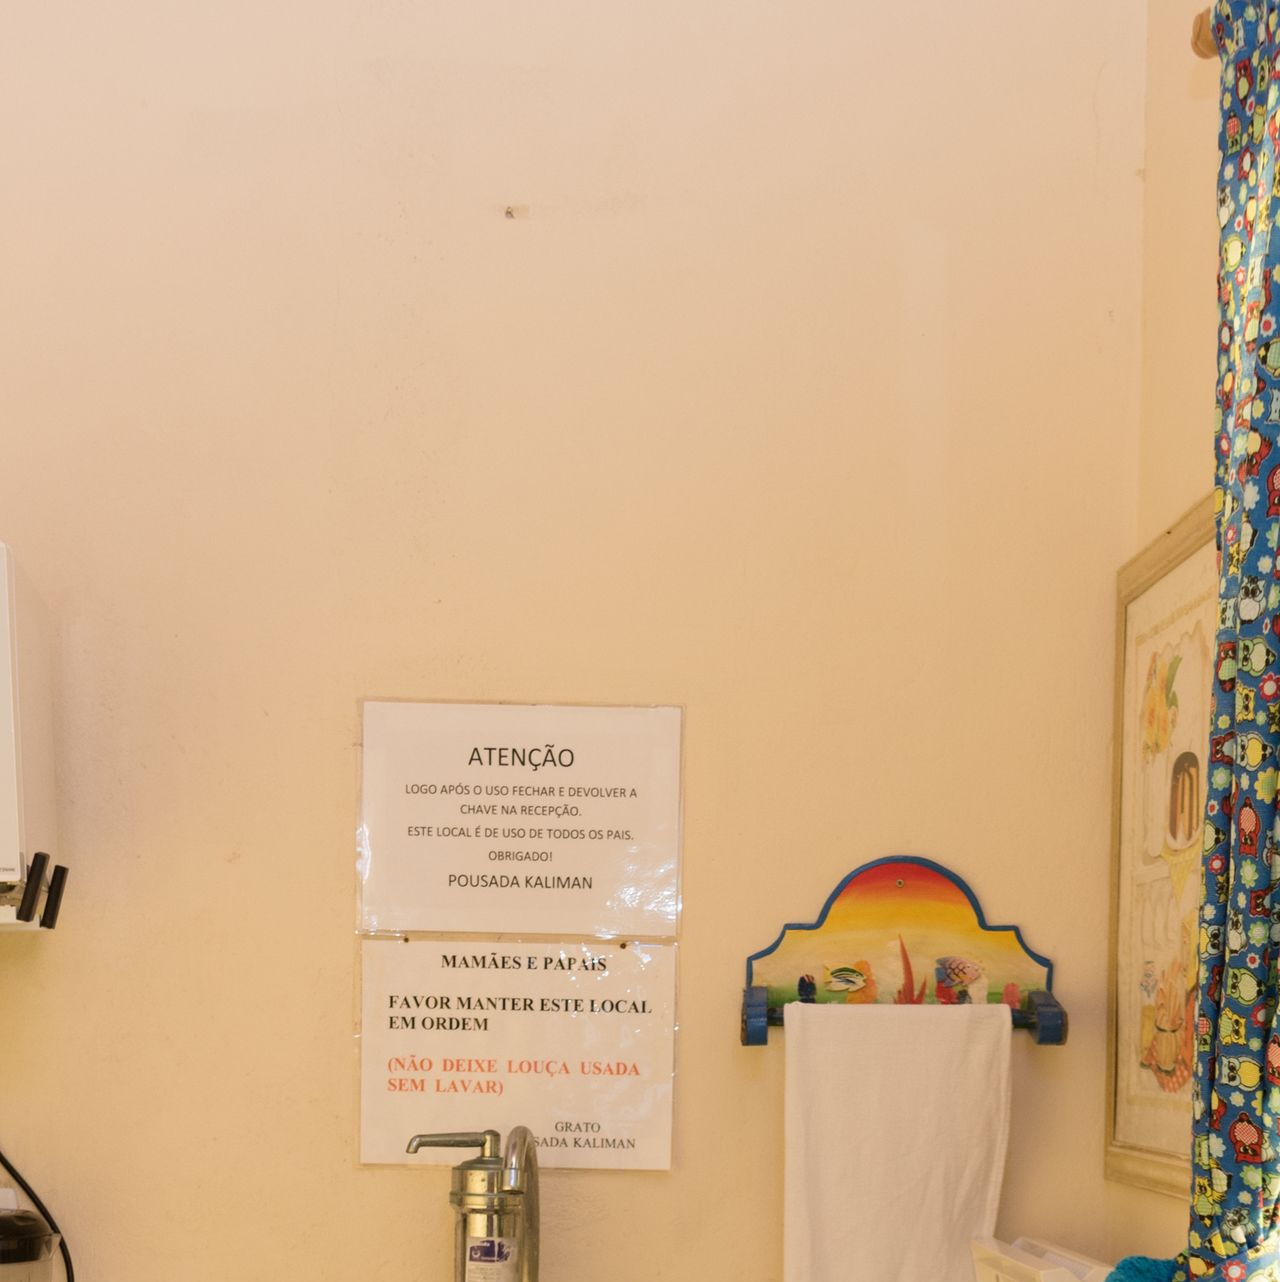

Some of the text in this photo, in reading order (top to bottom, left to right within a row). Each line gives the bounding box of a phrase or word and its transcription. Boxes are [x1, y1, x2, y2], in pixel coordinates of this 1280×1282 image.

[467, 743, 575, 772] ATENÇÃO
[405, 782, 638, 799] LOGO APÓS O USO FECHAR E DEVOLVER A
[459, 803, 582, 819] CHAVE NA RECEPÇÃO.
[407, 824, 635, 841] ESTE LOCAL É DE USO DE TODOS OS PAIS.
[488, 850, 553, 863] OBRIGADO!
[448, 873, 593, 890] POUSADA KALIMAN
[441, 952, 607, 972] MAMÃES E PAPAIS
[389, 995, 652, 1014] FAVOR MANTER ESTE LOCAL
[389, 1015, 489, 1032] EM ORDEM
[387, 1053, 641, 1078] (NÃO DEIXE LOUÇA USADA
[387, 1078, 504, 1097] SEM LAVAR)
[554, 1121, 601, 1134] GRATO
[533, 1136, 636, 1151] SADA KALIMAN
